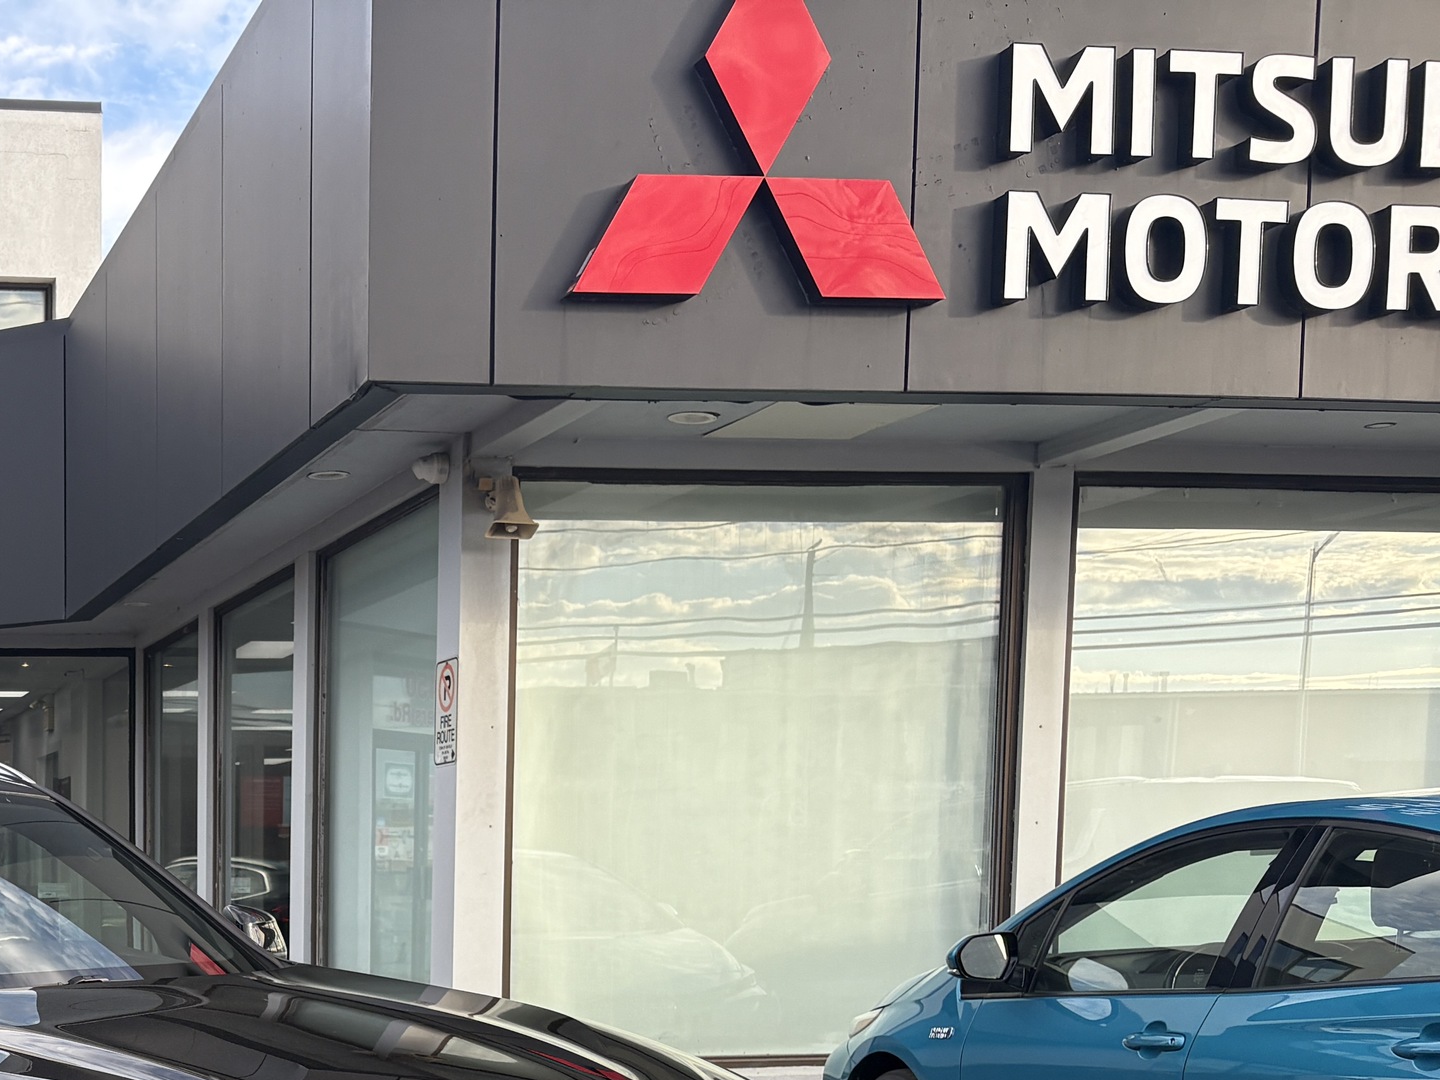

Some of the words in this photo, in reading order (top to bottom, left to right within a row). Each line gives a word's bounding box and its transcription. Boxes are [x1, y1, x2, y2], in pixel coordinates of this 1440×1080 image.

[1008, 41, 1440, 169] MITSU
[1003, 189, 1440, 312] MOTOR
[436, 728, 455, 745] ROUTE
[440, 714, 452, 729] FIRE
